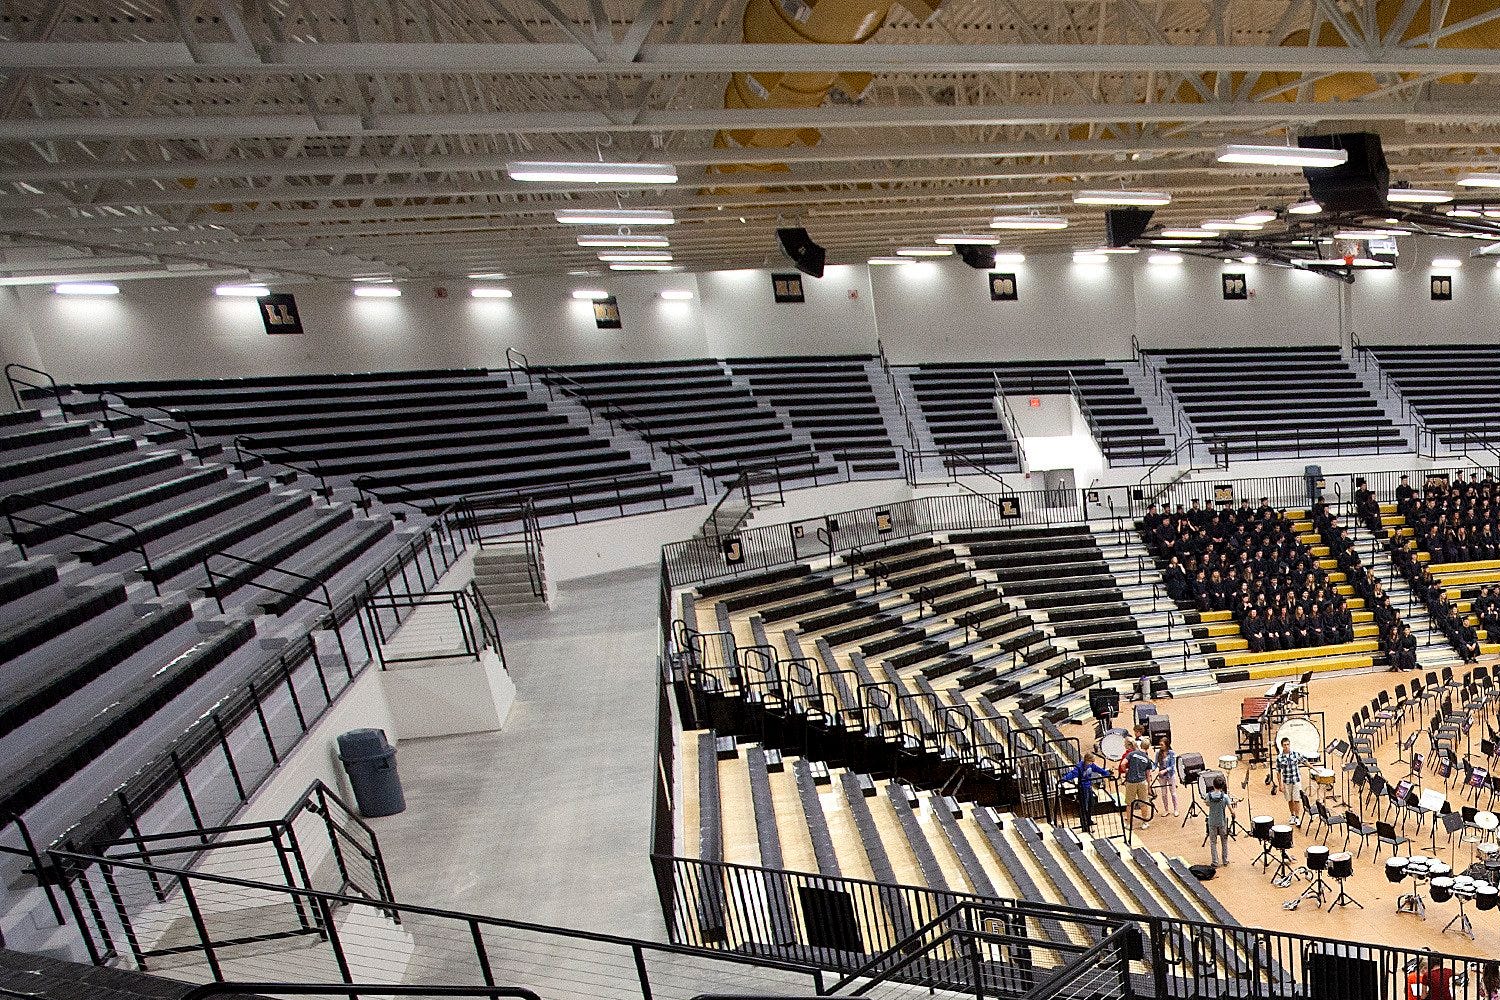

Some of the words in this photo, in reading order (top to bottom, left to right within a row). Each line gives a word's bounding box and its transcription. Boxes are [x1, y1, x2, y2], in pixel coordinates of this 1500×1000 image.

[1225, 279, 1243, 294] PP
[265, 304, 295, 324] LL
[1214, 488, 1233, 501] M
[1002, 501, 1017, 515] L
[877, 515, 891, 530] K
[796, 527, 804, 537] J
[728, 542, 740, 560] J
